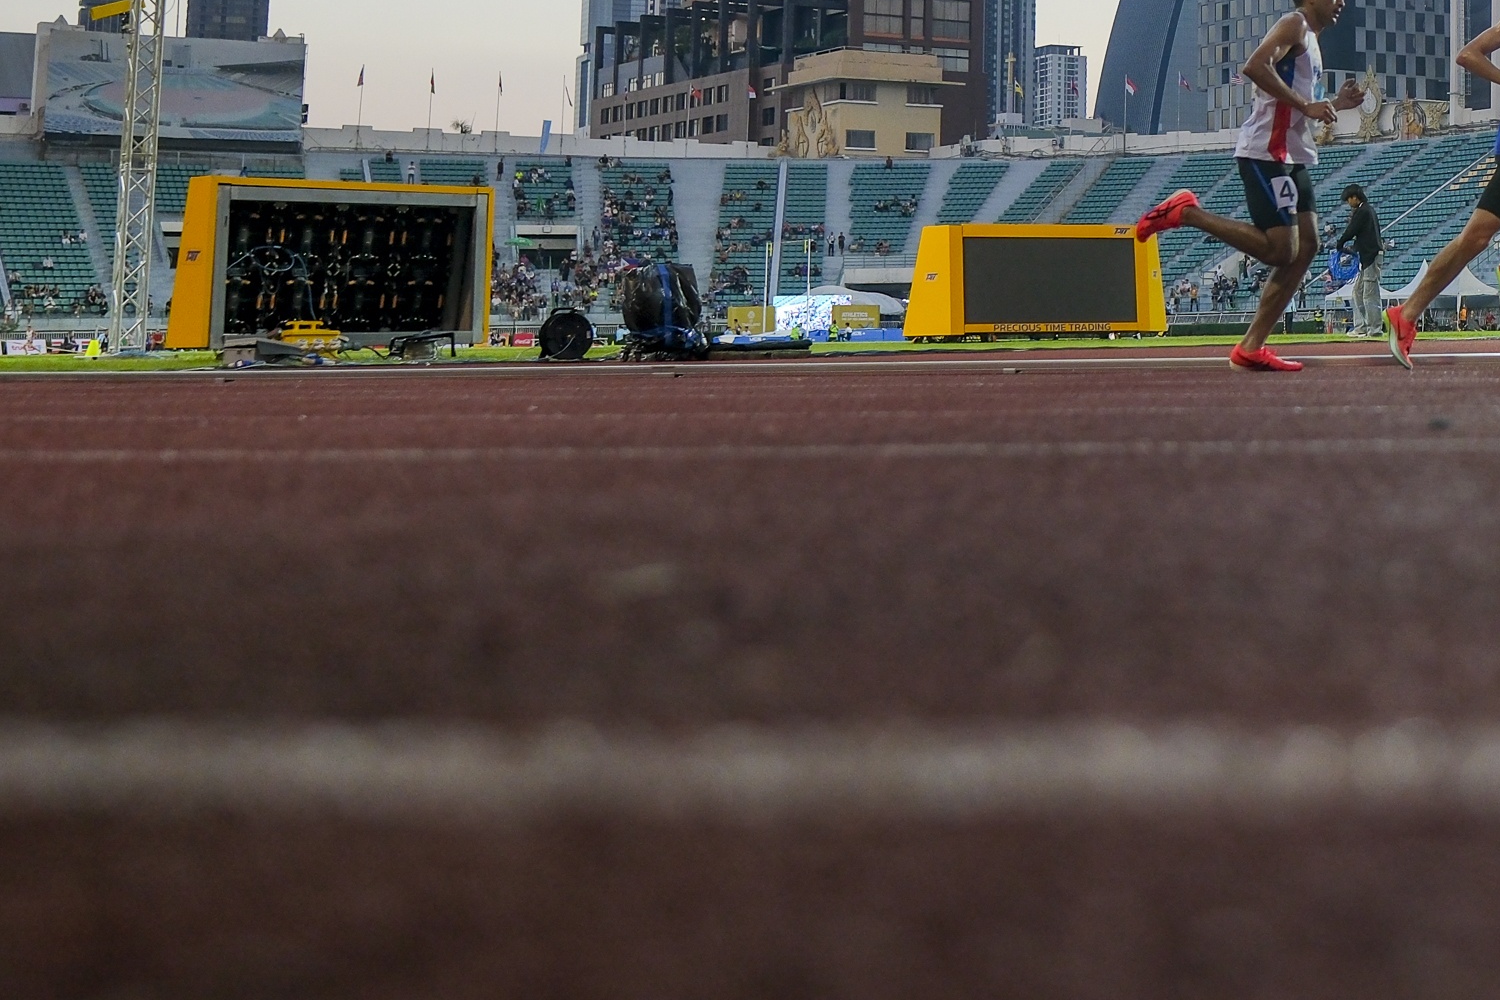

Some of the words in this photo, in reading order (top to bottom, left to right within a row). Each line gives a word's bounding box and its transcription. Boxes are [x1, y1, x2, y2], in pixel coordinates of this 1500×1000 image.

[1279, 180, 1294, 202] 4
[993, 324, 1041, 332] PRECIOUS
[1068, 323, 1111, 331] TRADING
